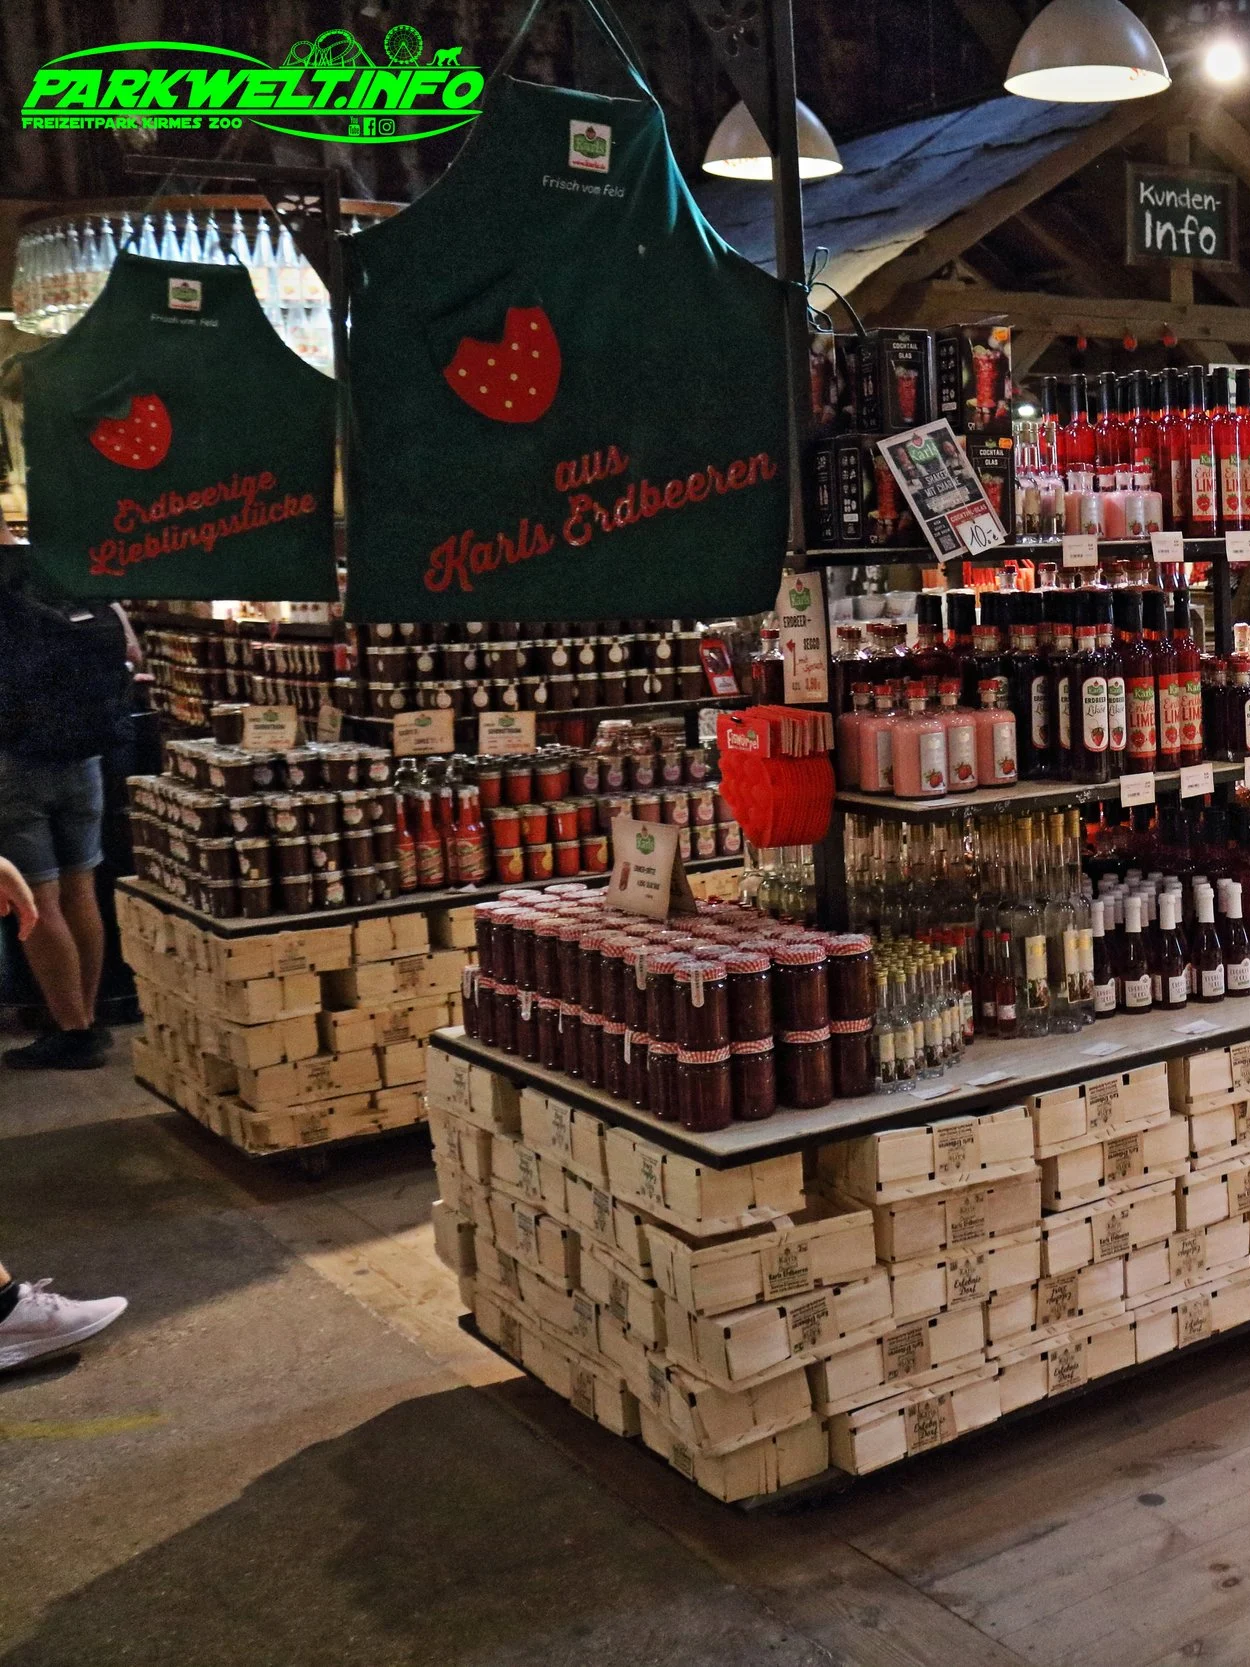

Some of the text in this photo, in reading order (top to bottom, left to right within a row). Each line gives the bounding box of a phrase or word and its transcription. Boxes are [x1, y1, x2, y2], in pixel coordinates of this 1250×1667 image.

[542, 175, 580, 192] Frisch
[1140, 181, 1221, 212] Kunden-
[1145, 209, 1217, 255] Info
[555, 445, 630, 492] aus
[113, 471, 277, 533] Erdbeerige
[424, 452, 777, 592] Karls Erdbeeren
[88, 493, 317, 577] Lieblingsstücke
